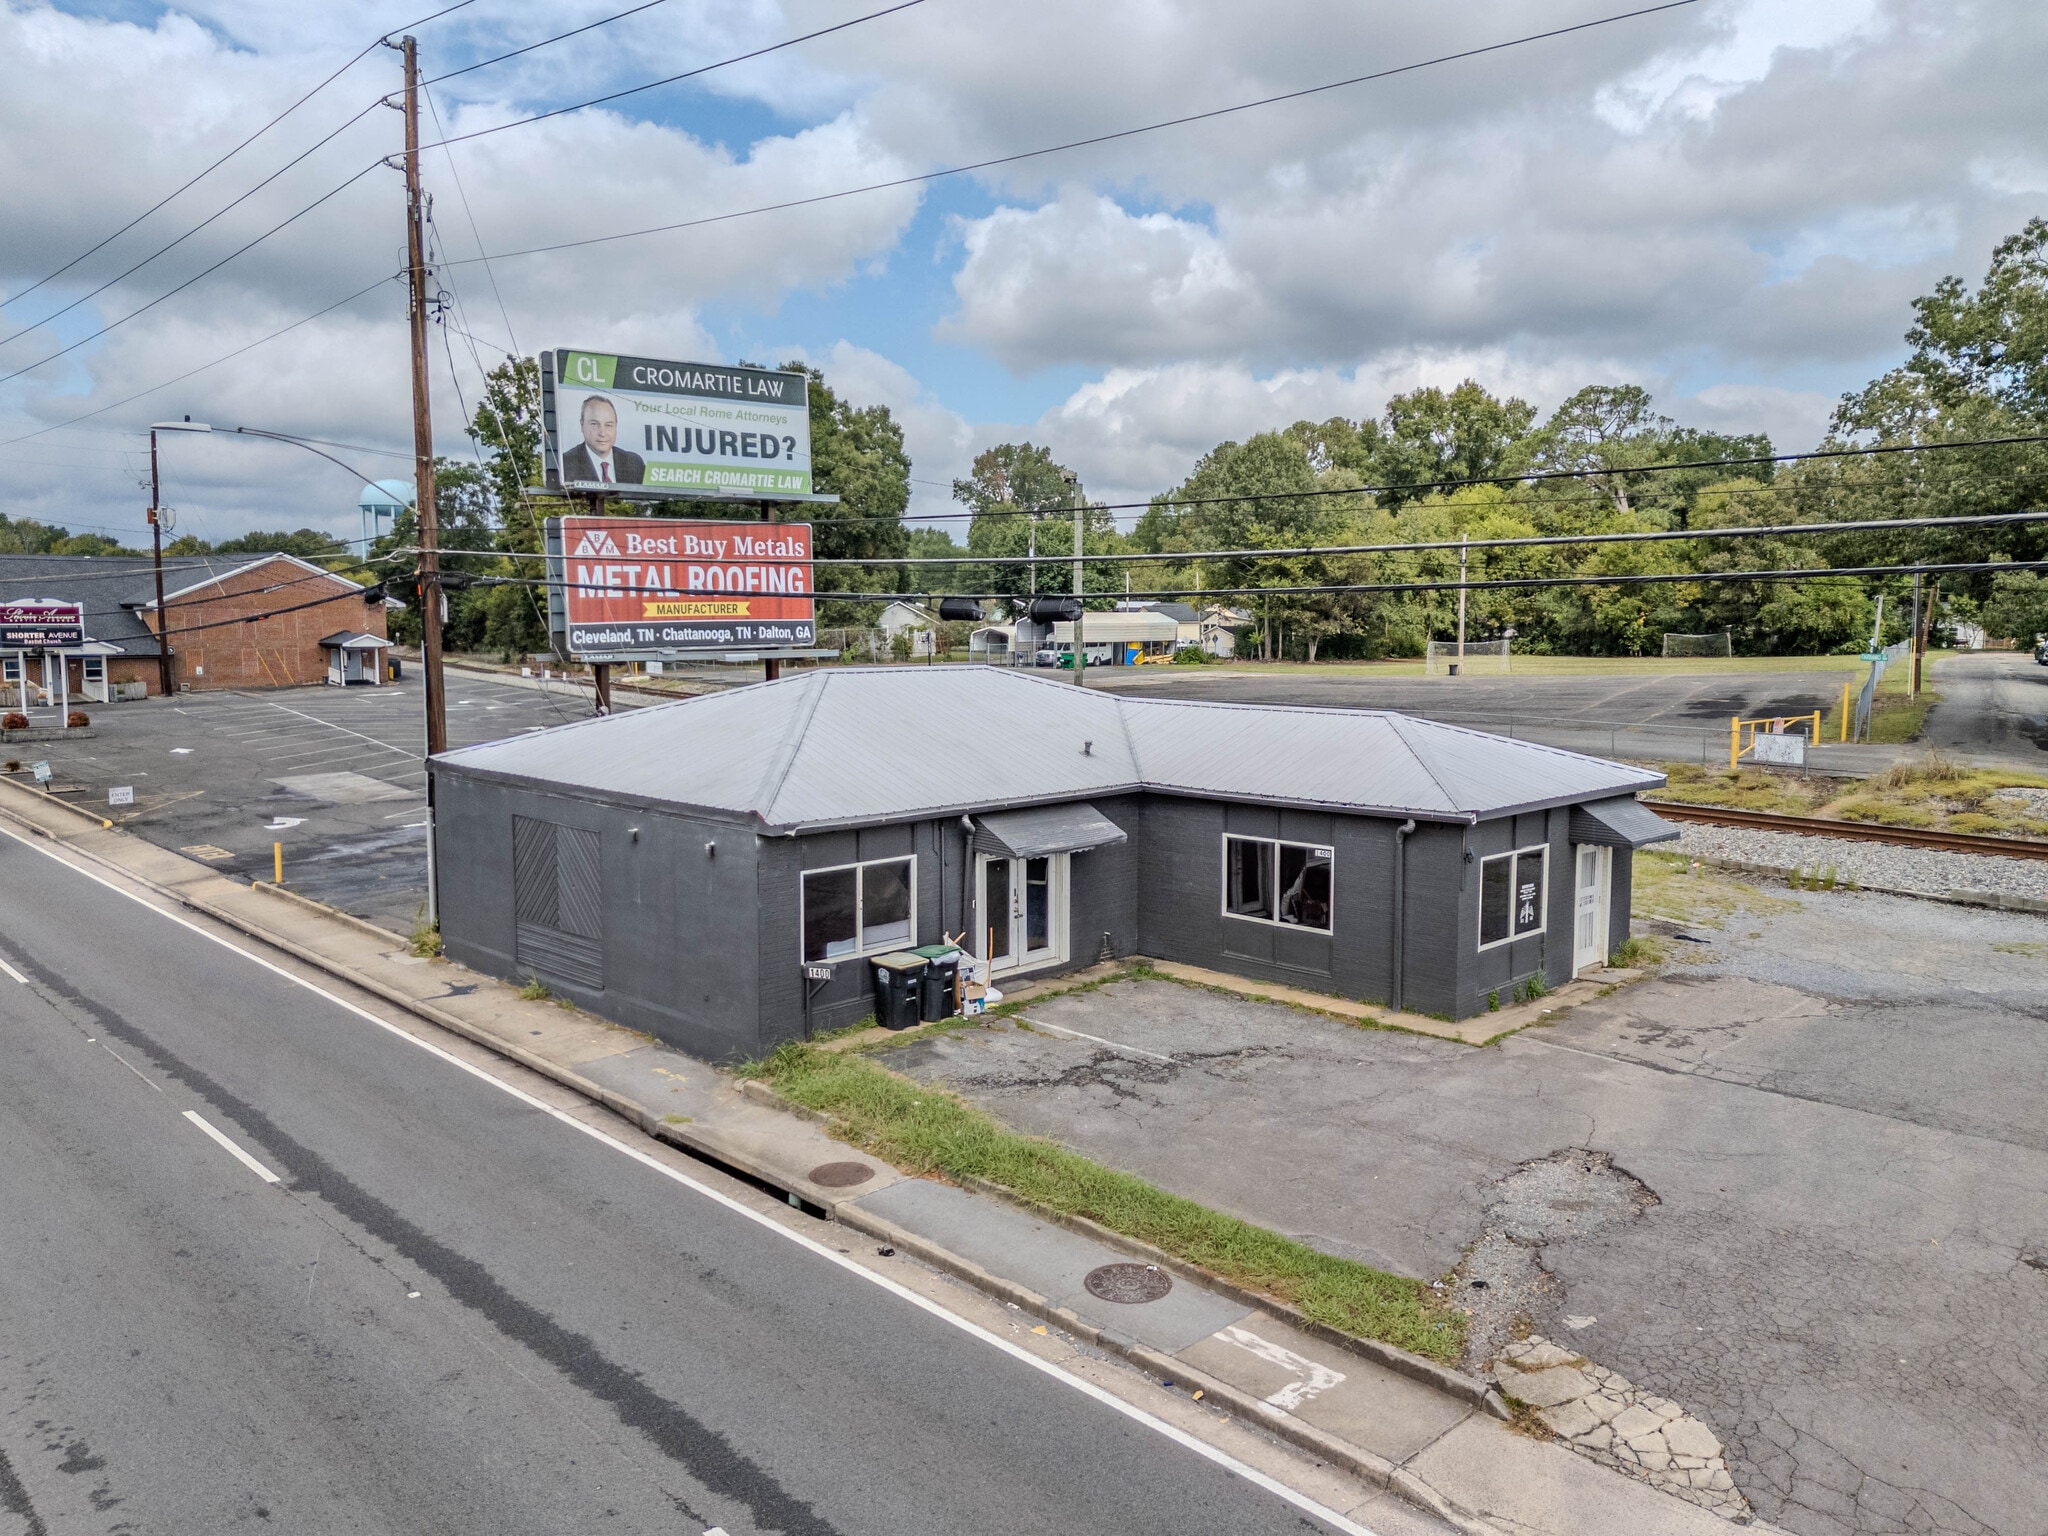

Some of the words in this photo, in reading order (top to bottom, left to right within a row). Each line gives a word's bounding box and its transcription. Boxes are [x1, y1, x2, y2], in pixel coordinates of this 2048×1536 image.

[577, 356, 606, 383] CL
[632, 366, 742, 394] CROMARTIE
[748, 378, 784, 397] LAW
[634, 400, 660, 414] Your
[665, 403, 696, 416] Local
[700, 405, 733, 419] Rome
[736, 409, 788, 425] Attorneys
[644, 424, 797, 460] INJURED?
[650, 467, 702, 484] SEARCH
[704, 470, 775, 488] CROMARTIE
[777, 474, 803, 489] LAW
[626, 533, 678, 555] Best
[684, 535, 728, 560] Buy
[733, 536, 805, 557] Metals
[577, 565, 680, 598] METAL
[688, 566, 804, 597] ROOFING
[656, 604, 738, 615] MANUFACTURER
[573, 628, 635, 645] Cleveland,
[637, 629, 655, 642] TN
[662, 627, 734, 642] Chattanooga,
[736, 626, 751, 639] TN
[758, 626, 794, 641] Dalton,
[796, 626, 811, 639] GA
[810, 968, 830, 979] 1400
